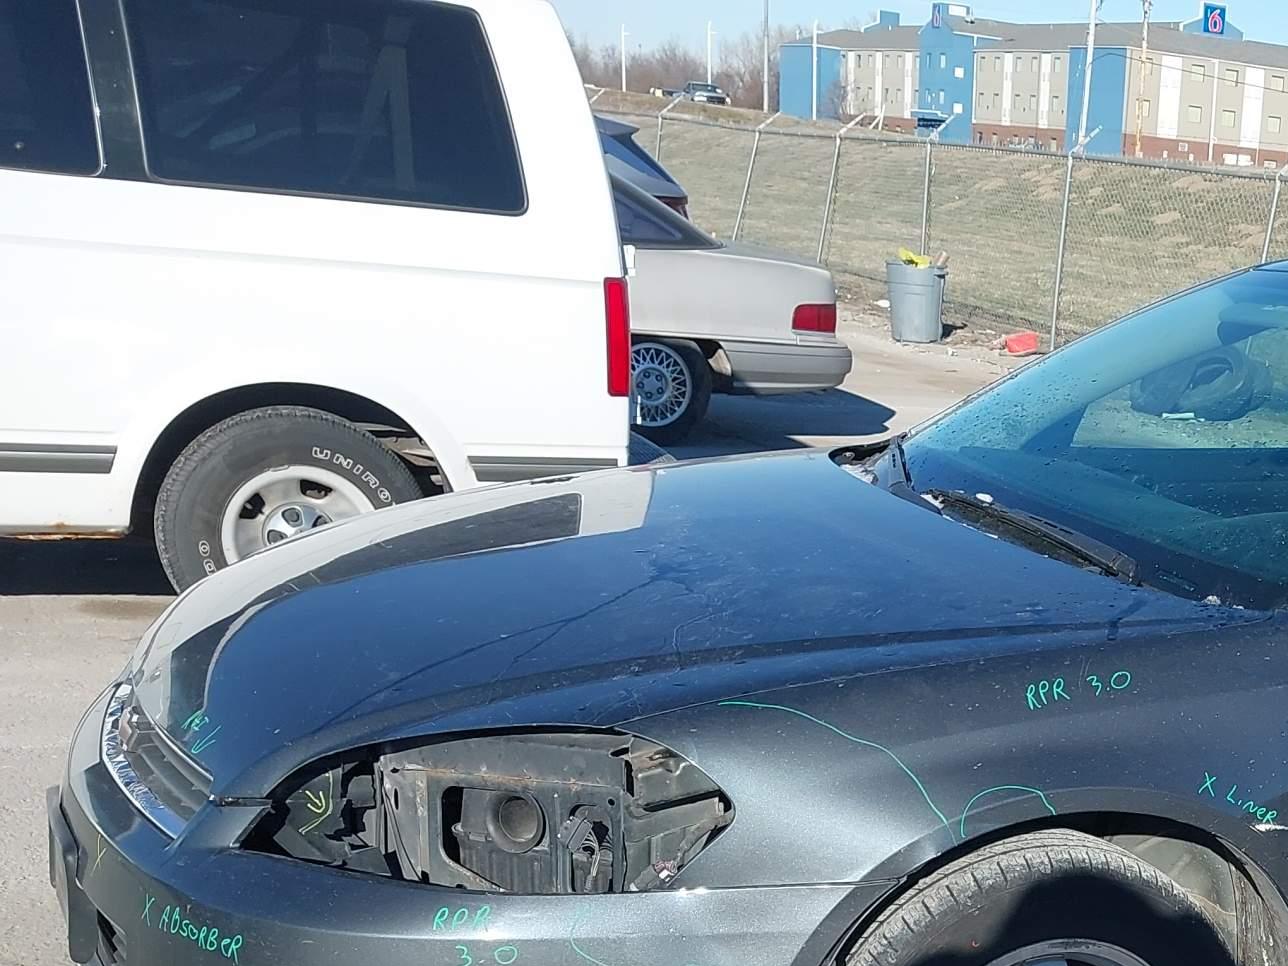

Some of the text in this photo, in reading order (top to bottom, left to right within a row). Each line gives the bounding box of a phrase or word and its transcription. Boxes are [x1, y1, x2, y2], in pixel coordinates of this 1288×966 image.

[1208, 9, 1223, 33] 6
[312, 446, 396, 506] UNIRO
[1026, 671, 1131, 710] RPR 3.0
[1198, 772, 1217, 797] X
[141, 893, 155, 927] X
[433, 907, 491, 932] RPR
